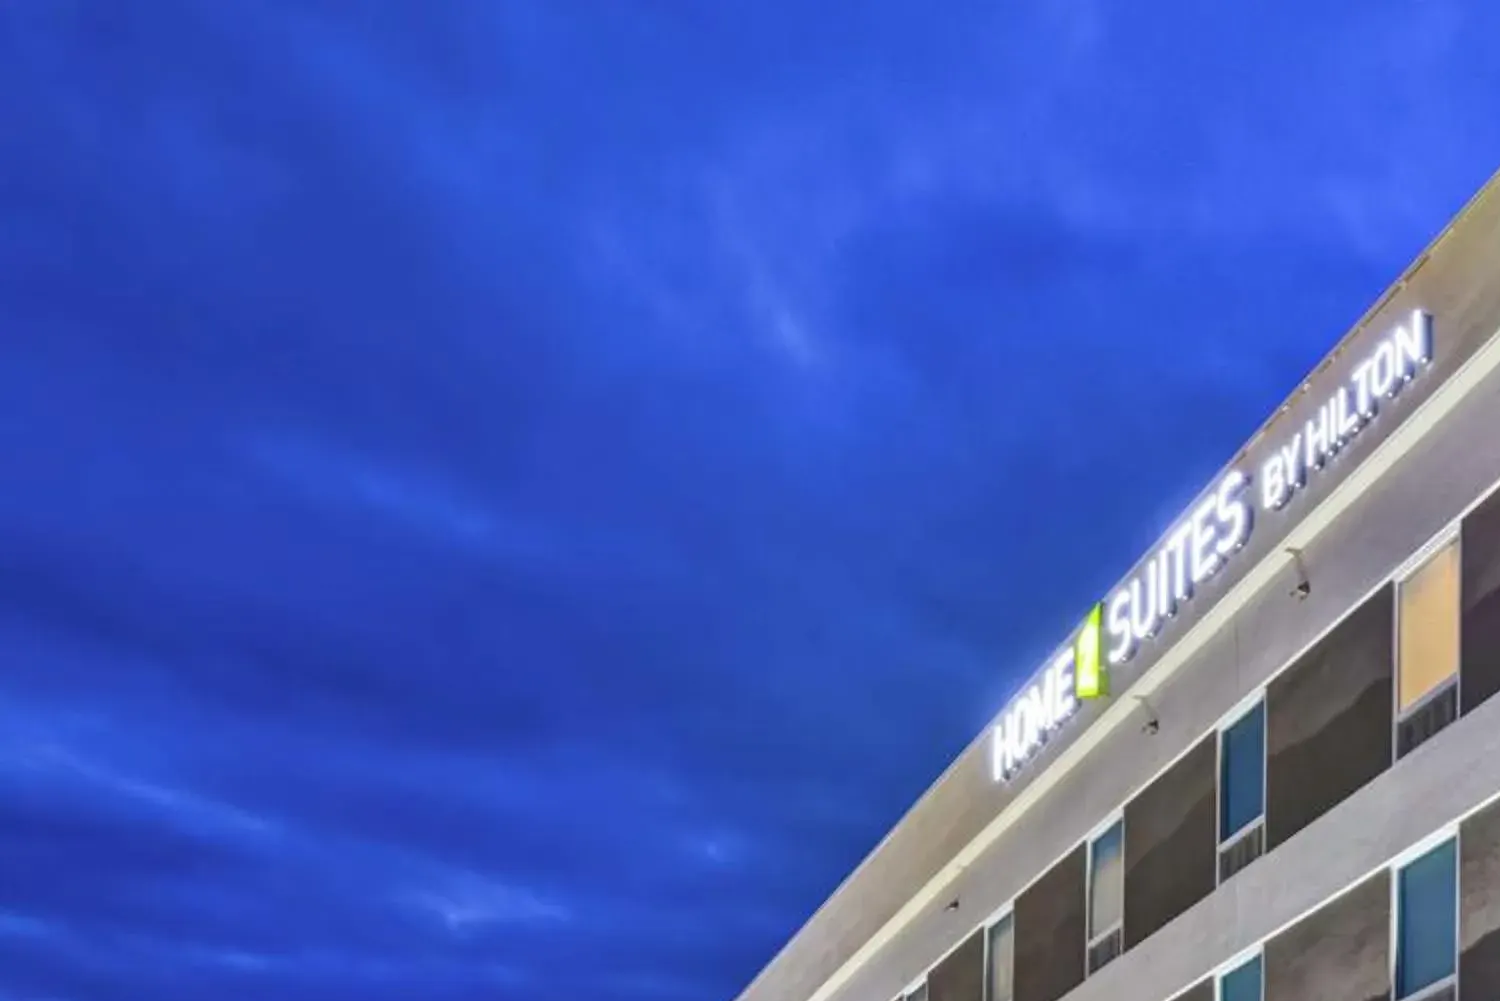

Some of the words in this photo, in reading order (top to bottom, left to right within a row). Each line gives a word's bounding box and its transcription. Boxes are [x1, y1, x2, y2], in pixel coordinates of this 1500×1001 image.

[992, 644, 1076, 783] HOME
[1107, 470, 1252, 664] SUITES
[1262, 433, 1301, 511] BY
[1305, 309, 1431, 471] HILTON
